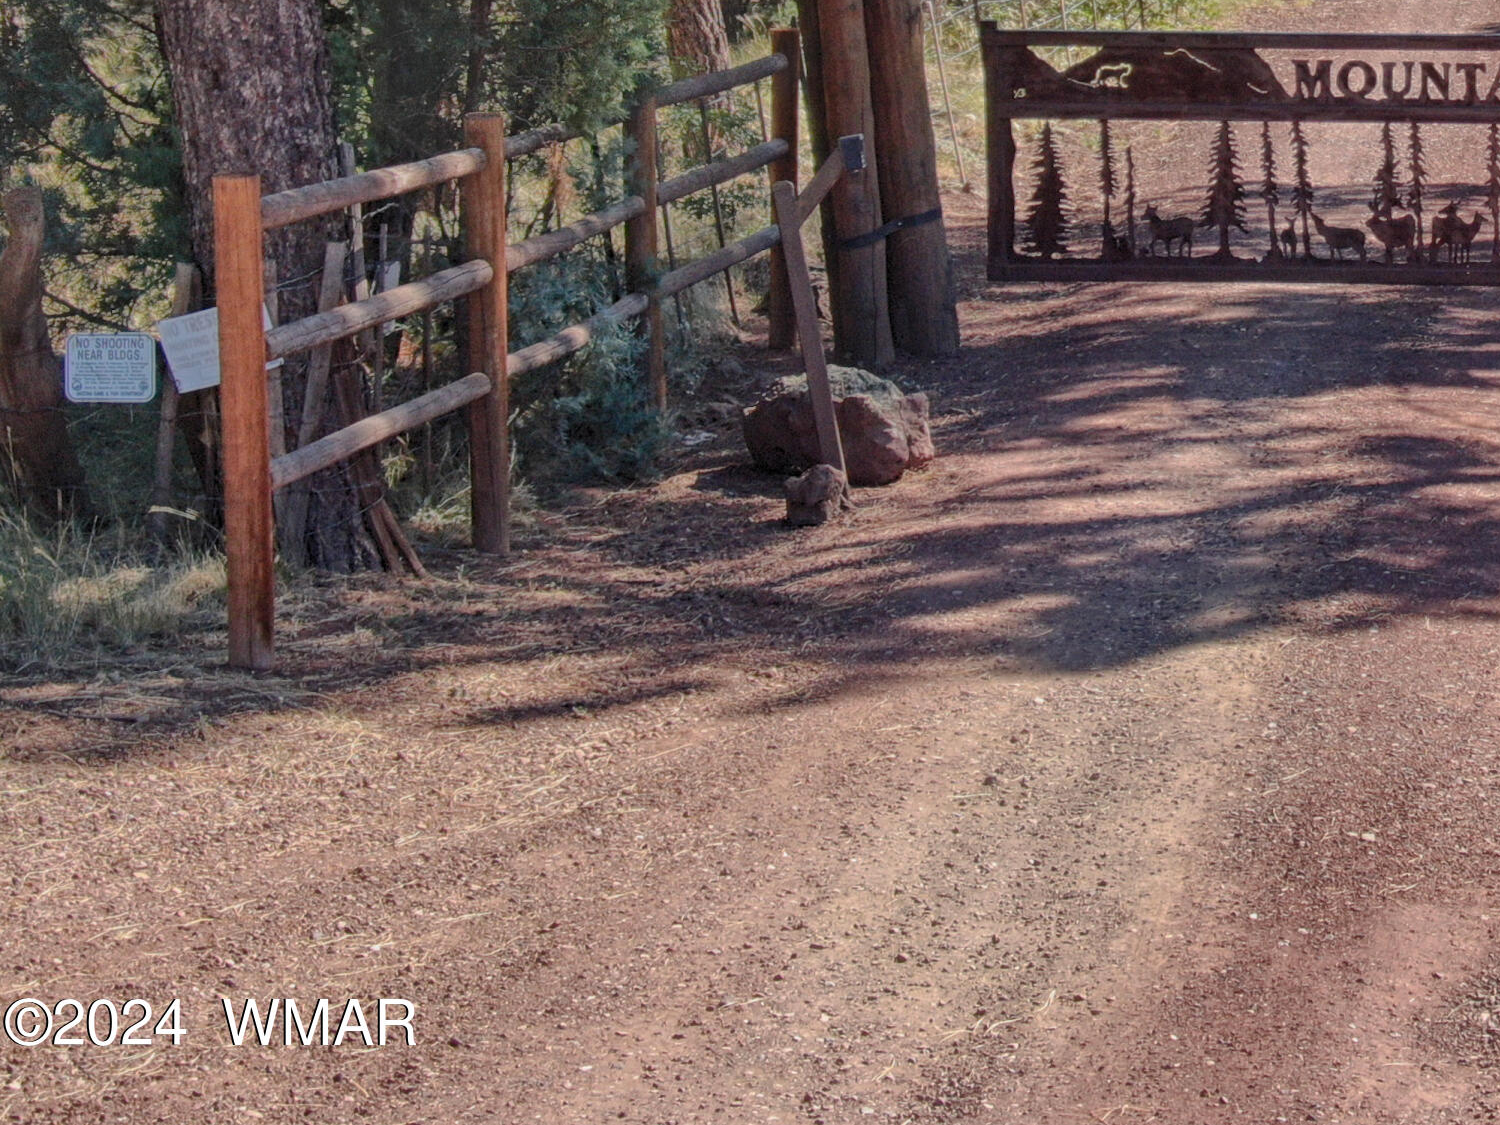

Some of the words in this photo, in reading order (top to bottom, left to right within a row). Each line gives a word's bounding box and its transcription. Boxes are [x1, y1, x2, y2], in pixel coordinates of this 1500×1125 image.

[76, 337, 89, 349] NO
[95, 338, 145, 349] SHOOTING
[77, 349, 103, 361] NEAR
[107, 349, 144, 361] BLDGS.
